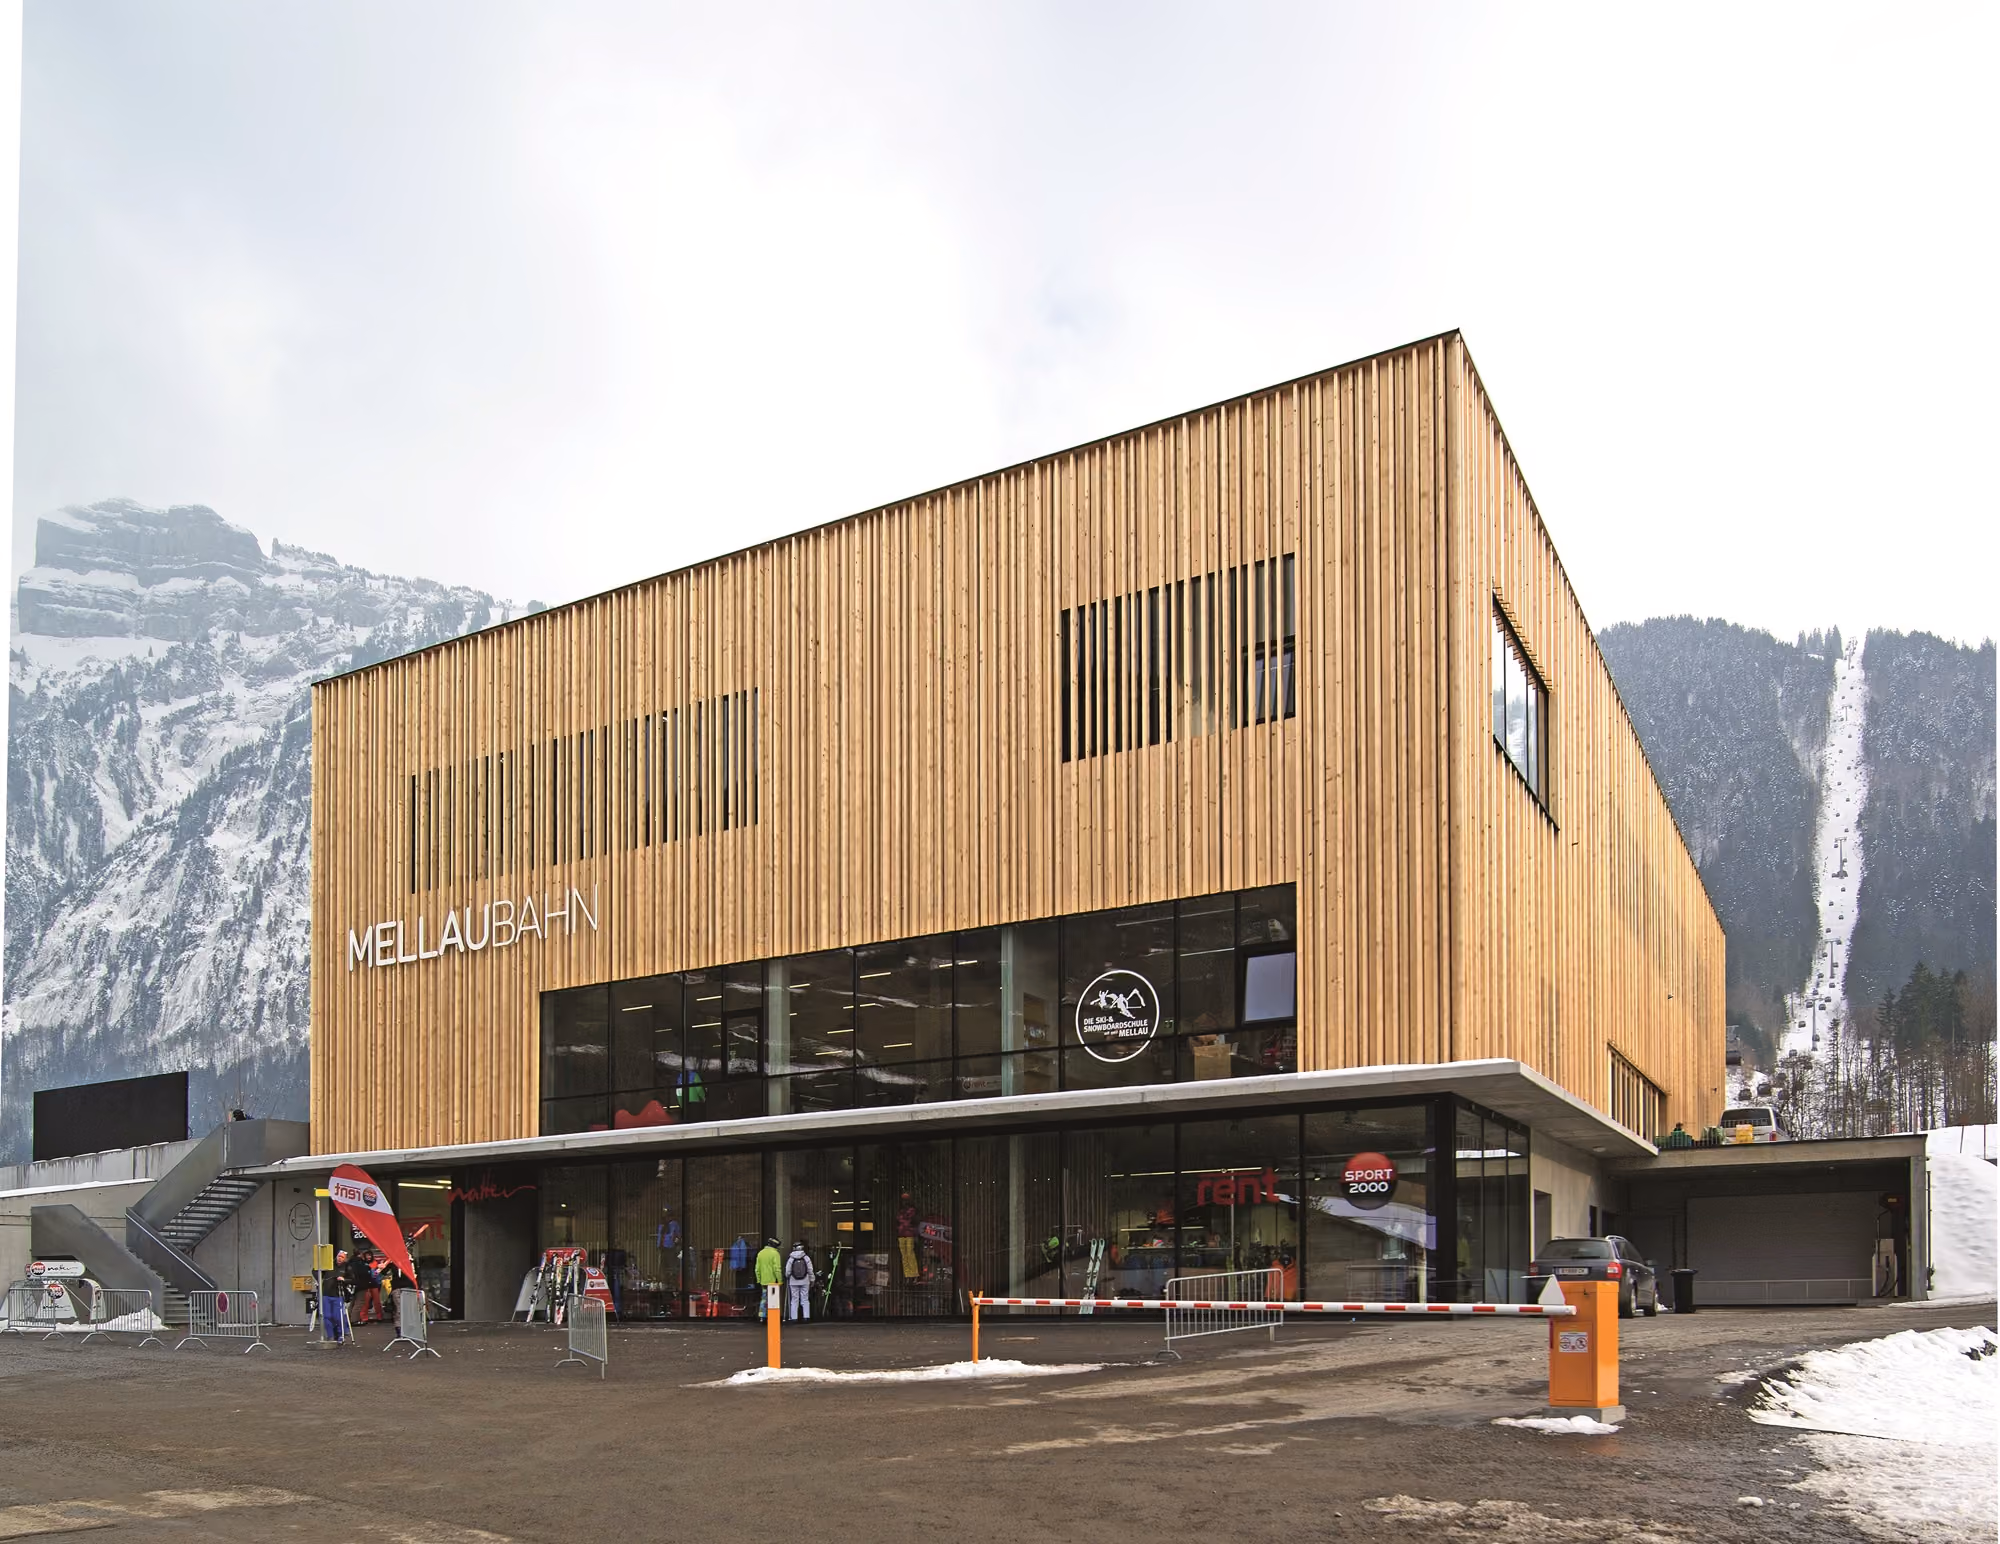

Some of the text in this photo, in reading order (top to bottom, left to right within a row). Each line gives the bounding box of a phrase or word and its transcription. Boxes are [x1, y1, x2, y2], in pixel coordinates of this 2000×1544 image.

[348, 883, 598, 971] MELLAUBAHN
[1083, 1017, 1095, 1026] DIE
[1083, 1019, 1148, 1033] SNOWBOARDSCHULE
[1118, 1026, 1149, 1038] MELLAU
[1344, 1168, 1393, 1182] SPORT
[1196, 1167, 1280, 1207] rent
[1349, 1181, 1389, 1194] 2000
